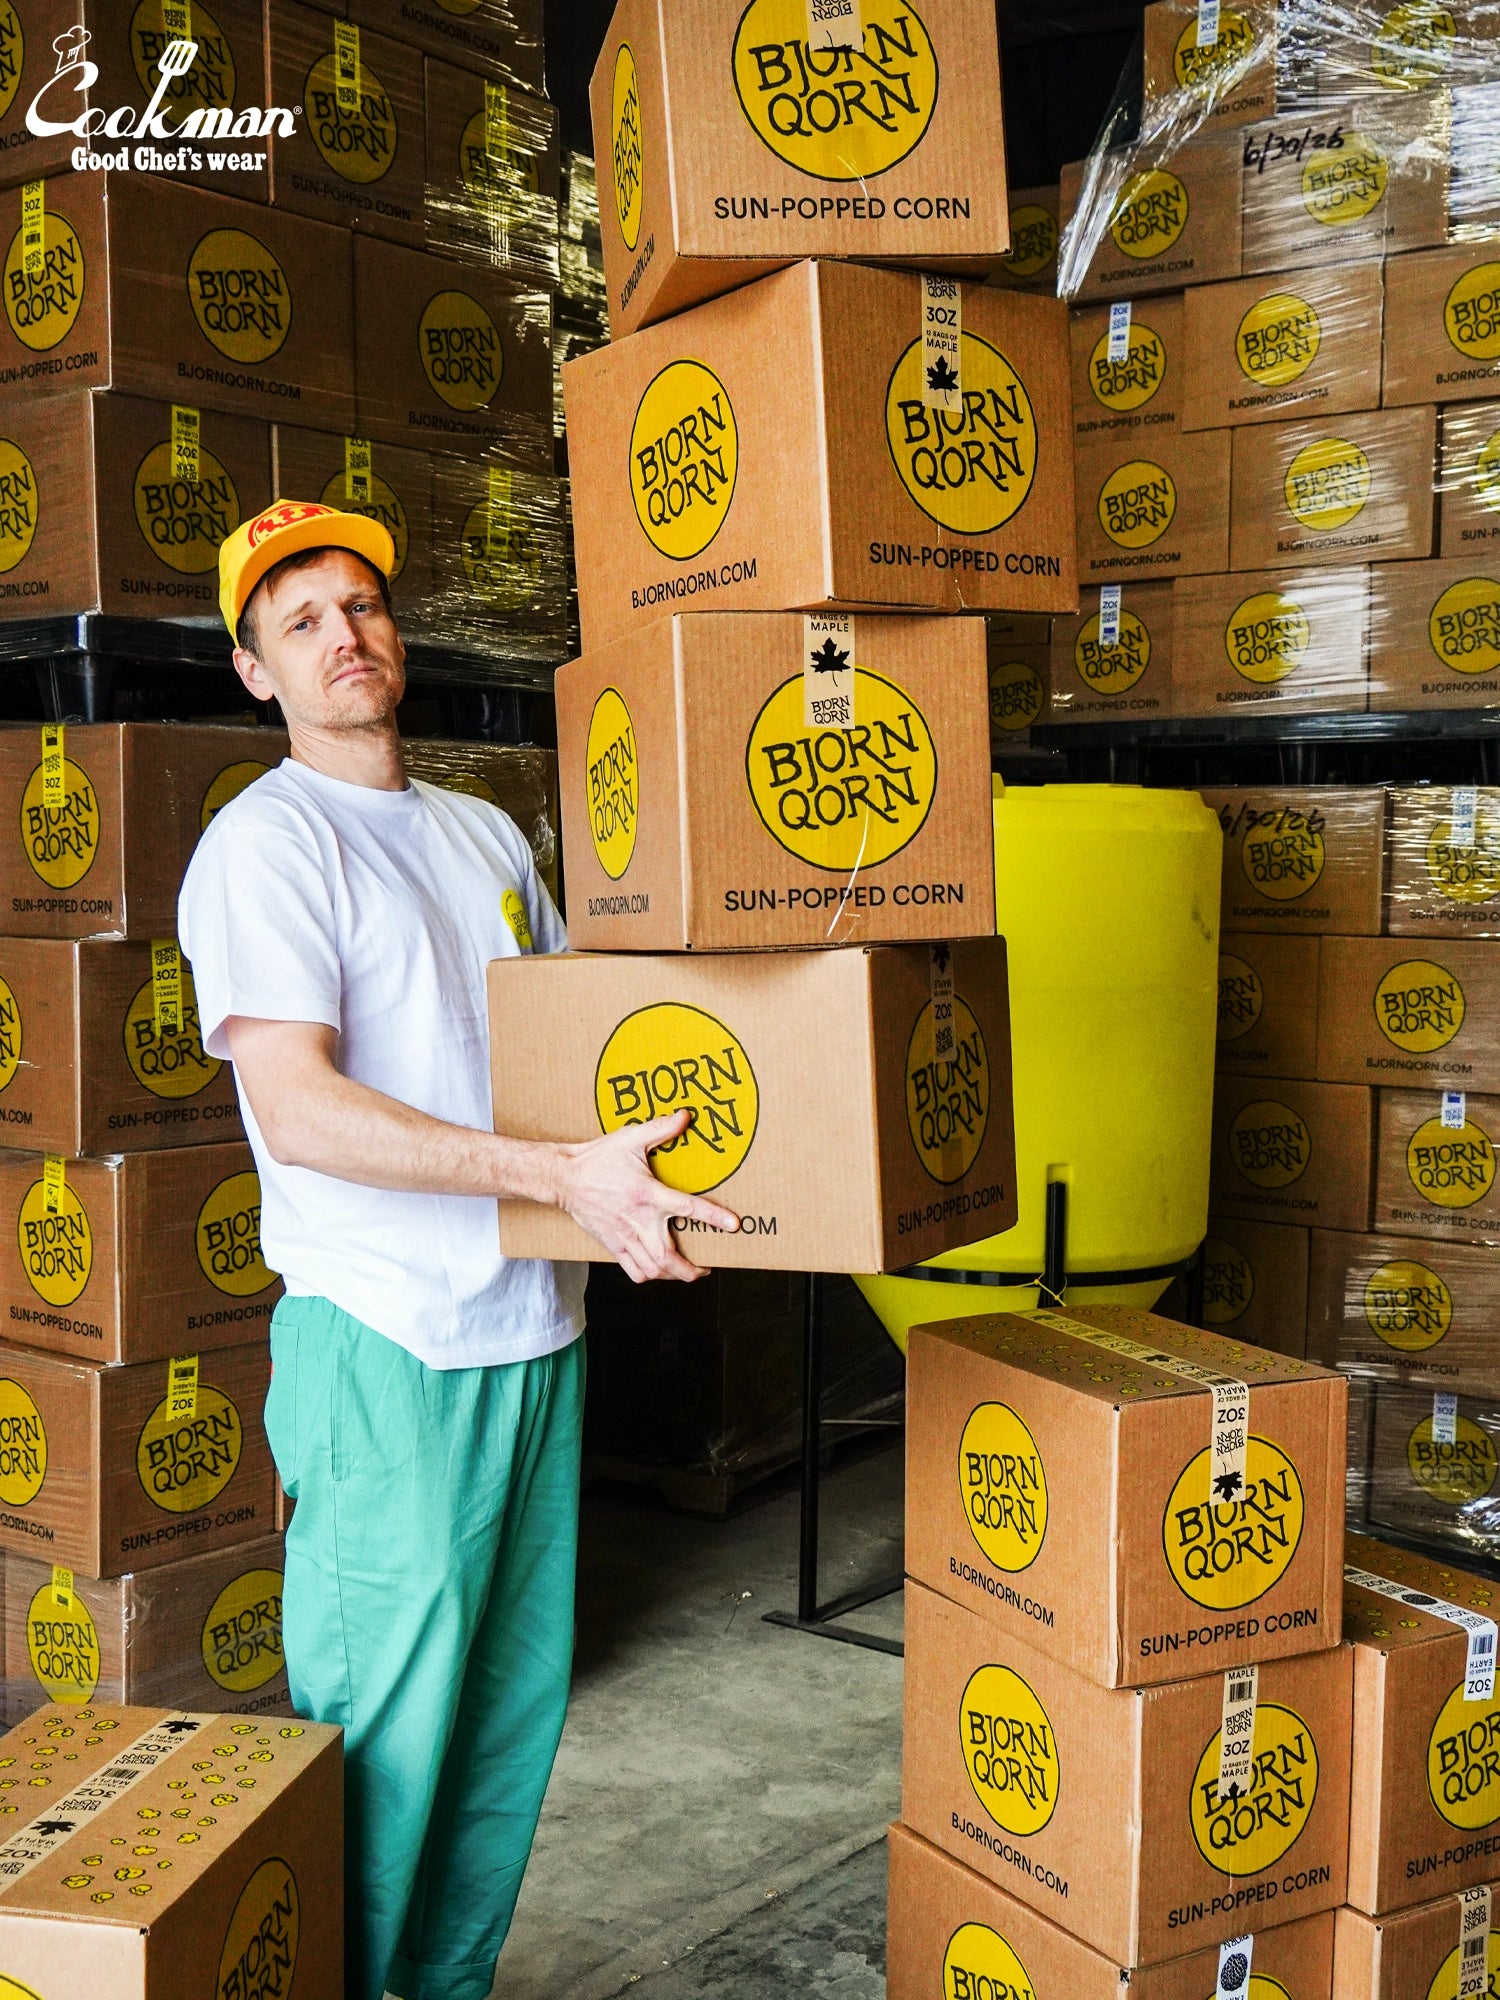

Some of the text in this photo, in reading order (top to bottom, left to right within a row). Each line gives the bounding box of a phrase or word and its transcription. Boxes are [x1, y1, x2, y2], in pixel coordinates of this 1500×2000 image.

[812, 2, 853, 21] BJORN
[767, 73, 920, 138] QORN
[319, 123, 388, 161] QORN
[1243, 126, 1344, 174] 6/30/26
[292, 174, 411, 220] SUN-POPPED CORN
[714, 197, 970, 220] SUN-POPPED CORN
[1118, 185, 1182, 230] BJORN
[1119, 210, 1181, 247] QORN
[196, 269, 283, 306] BJORN
[1100, 259, 1194, 284] BJORNQORN.COM
[15, 273, 77, 328] QORN
[927, 285, 957, 299] QORN
[204, 301, 283, 339] QORN
[926, 306, 957, 326] 3OZ
[1242, 310, 1312, 352] BJORN
[425, 327, 496, 360] BJORN
[926, 338, 957, 352] MAPLE
[933, 330, 948, 339] BAGS
[1095, 340, 1159, 379] BJORN
[1247, 338, 1311, 371] QORN
[177, 362, 300, 399] BJORNQORN.COM
[431, 357, 496, 390] QORN
[1100, 362, 1158, 398] QORN
[897, 384, 1024, 453] BJORN
[1076, 412, 1175, 433] SUN-POPPED CORN
[636, 393, 726, 491] BJORN
[911, 437, 1025, 492] QORN
[142, 476, 231, 521] BJORN
[648, 446, 728, 527] QORN
[1104, 478, 1169, 516] BJORN
[151, 509, 232, 547] QORN
[1109, 501, 1168, 534] QORN
[1277, 533, 1379, 551] BJORNQORN.COM
[869, 542, 1060, 576] SUN-POPPED CORN
[1090, 552, 1181, 570] BJORNQORN.COM
[120, 578, 212, 601] SUN-POPPED
[632, 559, 757, 609] BJORNQORN.COM
[811, 622, 849, 633] MAPLE
[1232, 611, 1302, 649] BJORN
[1085, 648, 1143, 679] QORN
[1237, 634, 1302, 666] QORN
[811, 695, 850, 714] BJORN
[990, 677, 1038, 702] BJORN
[814, 708, 850, 725] QORN
[991, 695, 1038, 718] QORN
[1065, 700, 1160, 713] SUN-POPPED CORN
[590, 726, 633, 805] BJORN
[762, 713, 920, 792] BJORN
[45, 777, 60, 788] 3OZ
[778, 766, 920, 831] QORN
[26, 786, 93, 837] BJORN
[593, 780, 634, 842] QORN
[1219, 803, 1325, 838] 6/30/26
[32, 822, 93, 862] QORN
[1249, 831, 1317, 864] BJORN
[1253, 853, 1316, 883] QORN
[12, 898, 112, 913] SUN-POPPED CORN
[588, 894, 650, 916] BJORNQORN.COM
[724, 883, 964, 912] SUN-POPPED CORN
[1233, 906, 1330, 920] BJORNQORN.COM
[1410, 911, 1487, 922] SUN-POPPED
[155, 968, 177, 980] 3OZ
[935, 1003, 953, 1020] 3OZ
[1382, 983, 1457, 1016] BJORN
[1387, 1007, 1454, 1034] QORN
[911, 1031, 981, 1115] BJORN
[1366, 1057, 1472, 1074] BJORNQORN.COM
[607, 1047, 742, 1118] BJORN
[108, 1107, 199, 1129] SUN-POPPED
[920, 1081, 983, 1151] QORN
[1235, 1122, 1304, 1153] BJORN
[1240, 1146, 1303, 1171] QORN
[1414, 1140, 1488, 1171] BJORN
[1419, 1165, 1486, 1190] QORN
[898, 1184, 1004, 1235] SUN-POPPED CORN
[24, 1212, 85, 1253] BJORN
[29, 1246, 85, 1281] QORN
[1370, 1285, 1445, 1310] BJORN
[10, 1307, 103, 1339] SUN-POPPED CORN
[1375, 1309, 1443, 1334] QORN
[1355, 1351, 1460, 1377] BJORNQORN.COM
[172, 1398, 194, 1411] 3OZ
[1216, 1385, 1246, 1396] MAPLE
[1217, 1407, 1246, 1423] 3OZ
[1436, 1406, 1455, 1416] 3OZ
[145, 1407, 234, 1468] BJORN
[1216, 1437, 1245, 1456] BJORN
[1217, 1428, 1243, 1445] QORN
[1414, 1440, 1490, 1466] BJORN
[153, 1440, 233, 1493] QORN
[965, 1451, 1039, 1502] BJORN
[970, 1491, 1038, 1543] QORN
[1175, 1469, 1291, 1547] BJORN
[121, 1506, 255, 1551] SUN-POPPED CORN
[1183, 1513, 1289, 1580] QORN
[949, 1557, 1054, 1628] BJORNQORN.COM
[32, 1621, 94, 1654] BJORN
[1140, 1608, 1317, 1657] SUN-POPPED CORN
[38, 1650, 93, 1687] QORN
[1228, 1668, 1255, 1680] MAPLE
[1469, 1658, 1493, 1668] EARTH
[1467, 1678, 1492, 1694] 3OZ
[1225, 1708, 1252, 1728] BJORN
[1226, 1720, 1251, 1736] QORN
[133, 1743, 173, 1753] 3OZ
[967, 1711, 1050, 1767] BJORN
[1223, 1740, 1250, 1757] 3OZ
[90, 1777, 130, 1786] MAPLE
[973, 1750, 1049, 1810] QORN
[1221, 1767, 1249, 1778] MAPLE
[74, 1788, 117, 1798] 3OZ
[1208, 1777, 1306, 1849] QORN
[14, 1837, 57, 1845] MAPLE
[951, 1812, 1068, 1898] BJORNQORN.COM
[1406, 1835, 1500, 1879] SUN-POPPED
[1168, 1864, 1330, 1928] SUN-POPPED CORN
[222, 1879, 292, 1999] BJORN
[1461, 1958, 1485, 1971] MAPLE
[1460, 1976, 1484, 1996] 3OZ
